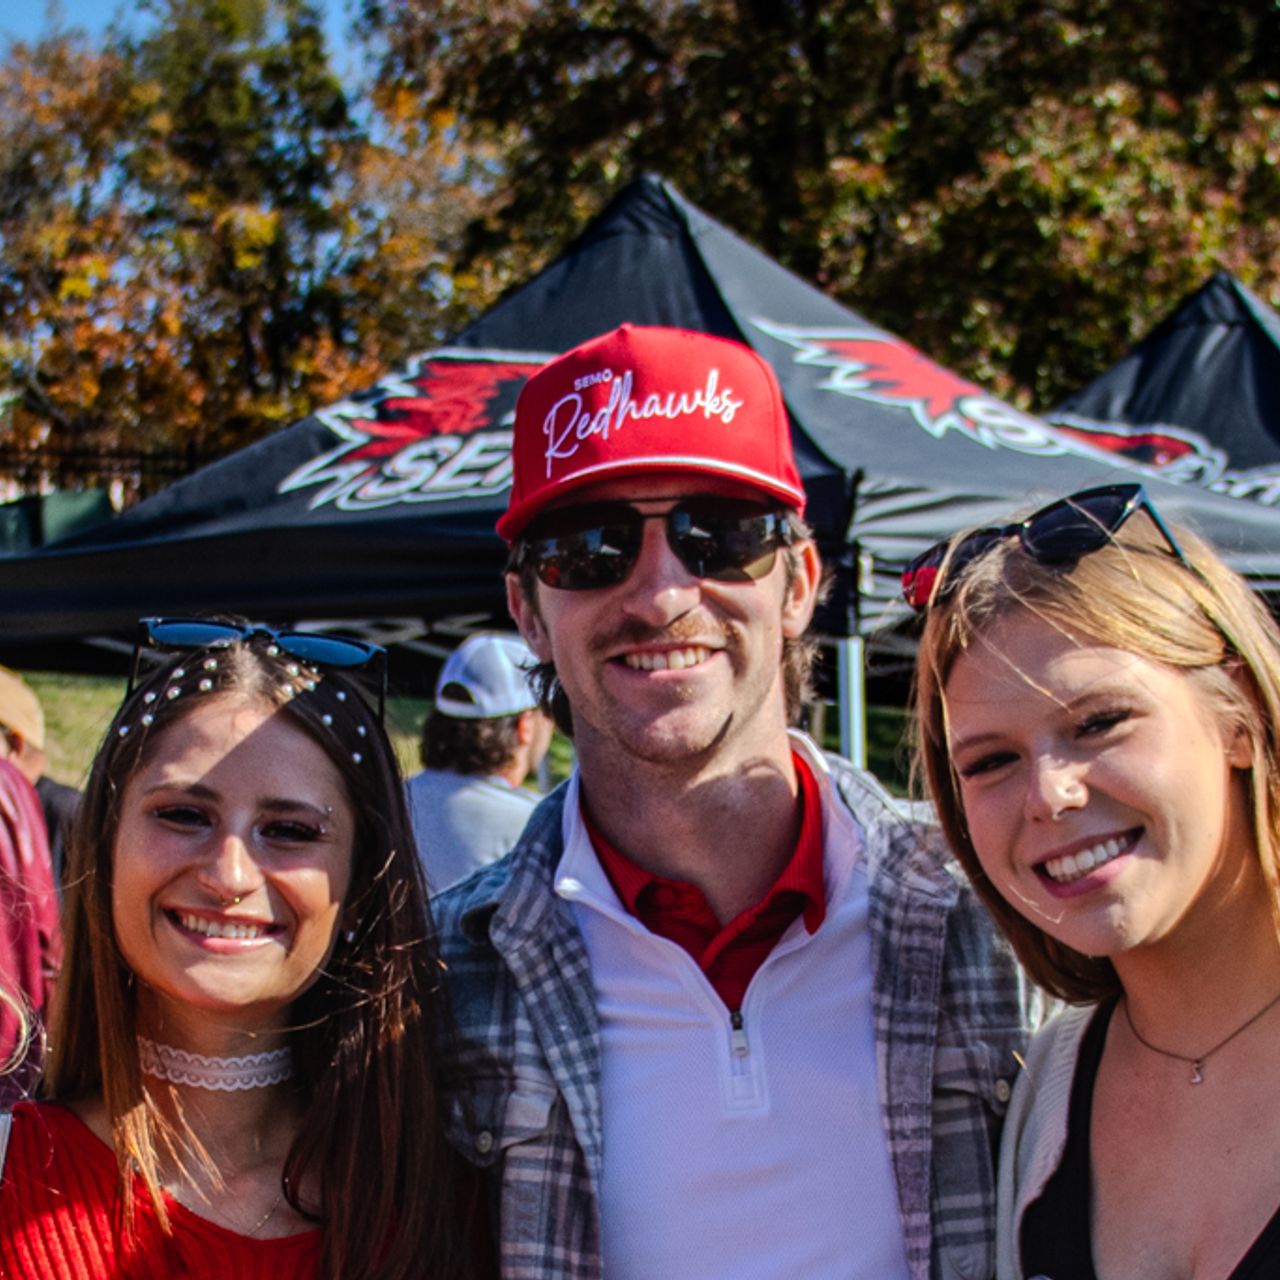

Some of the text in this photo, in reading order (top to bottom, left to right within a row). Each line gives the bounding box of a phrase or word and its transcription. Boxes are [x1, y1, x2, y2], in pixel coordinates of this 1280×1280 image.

[573, 368, 614, 391] SEMO
[542, 368, 744, 479] Redhawks
[354, 430, 516, 495] SE
